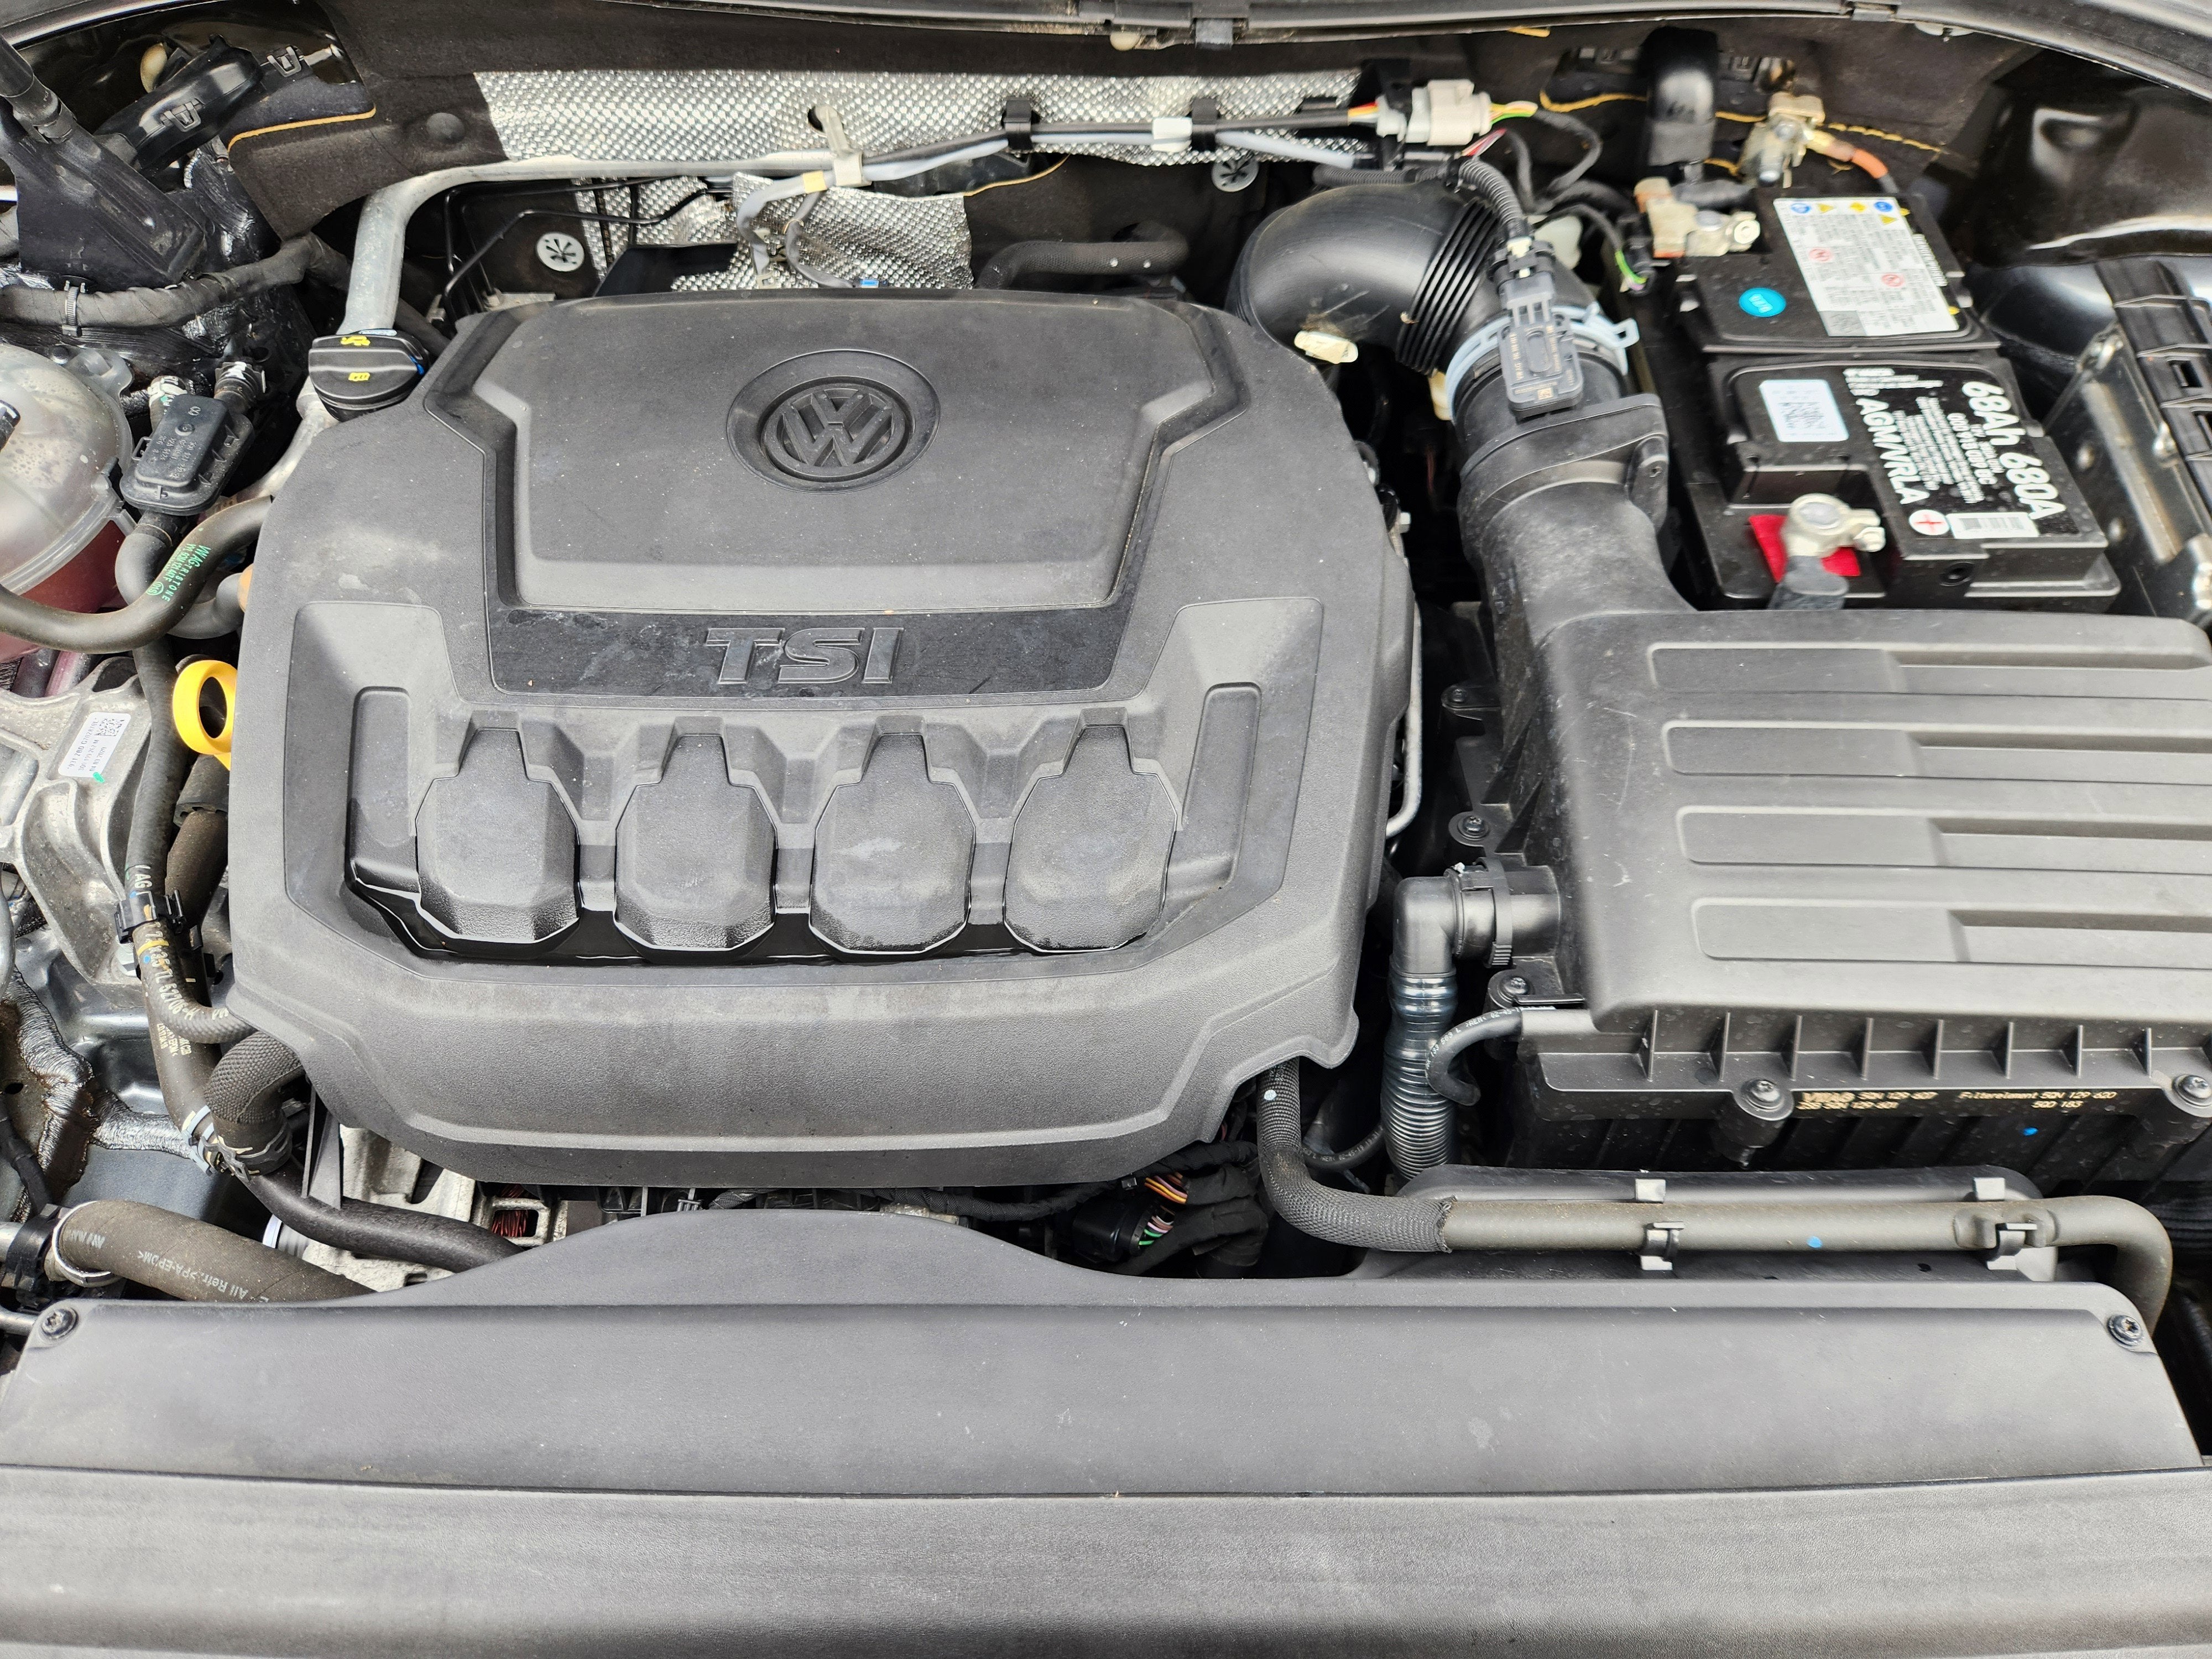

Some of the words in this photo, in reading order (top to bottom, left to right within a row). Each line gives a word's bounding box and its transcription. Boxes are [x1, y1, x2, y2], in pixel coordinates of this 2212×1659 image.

[770, 385, 900, 471] VW
[1962, 381, 2026, 446] 68Ah
[1999, 452, 2067, 520] 680A
[161, 564, 192, 602] TRISTONE
[705, 627, 905, 685] TSI
[155, 968, 174, 984] TL
[229, 1284, 249, 1300] All
